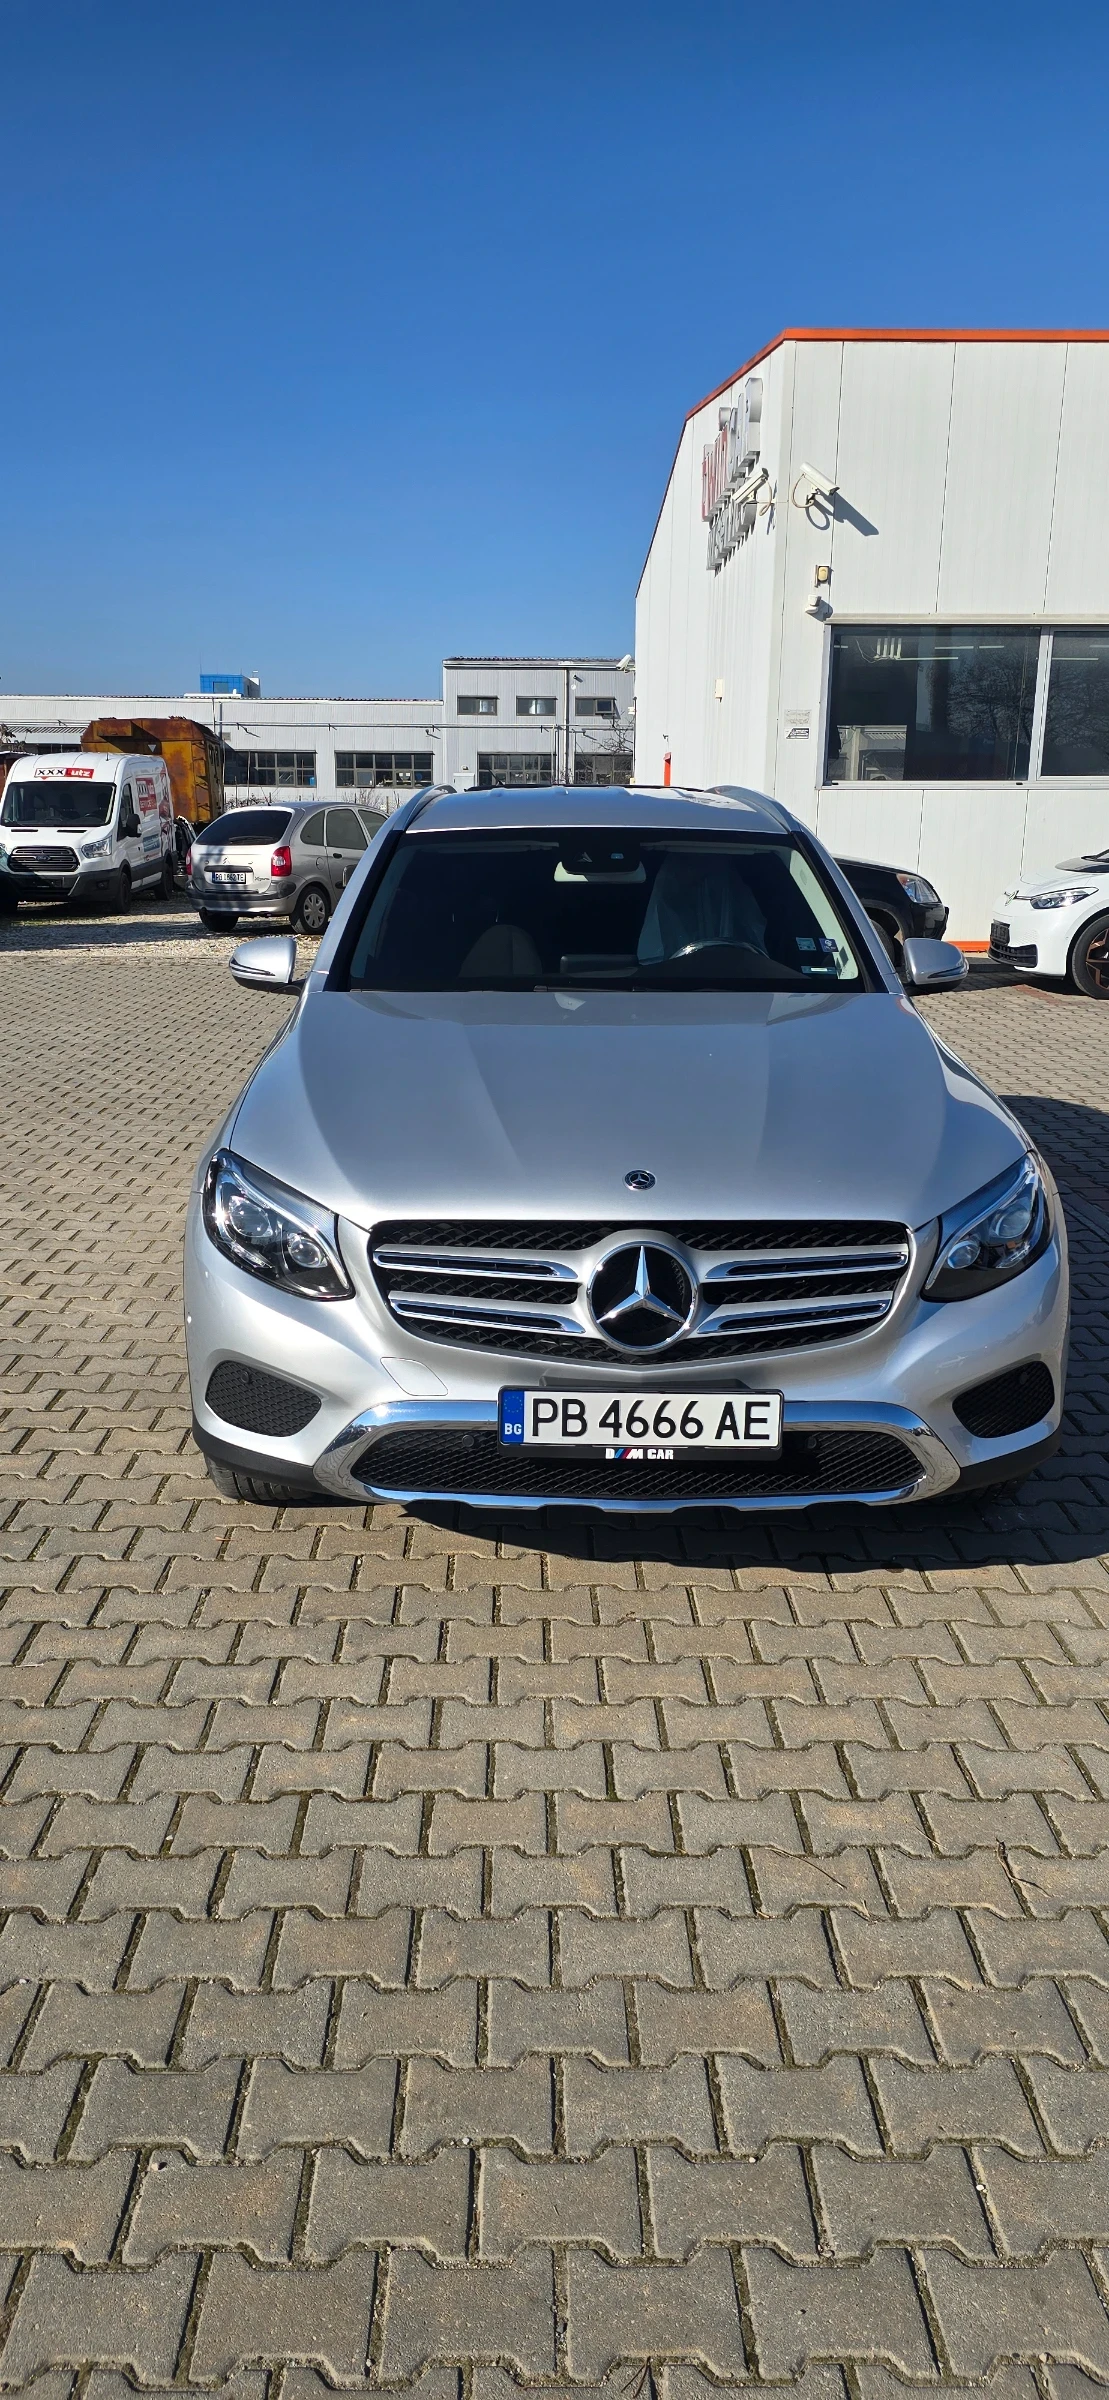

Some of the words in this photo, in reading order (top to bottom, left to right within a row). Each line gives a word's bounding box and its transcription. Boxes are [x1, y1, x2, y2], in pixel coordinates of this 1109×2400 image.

[531, 1397, 588, 1439] PB
[598, 1399, 704, 1440] 4666
[714, 1401, 771, 1441] AE
[504, 1422, 522, 1436] BG
[647, 1448, 674, 1460] CAR
